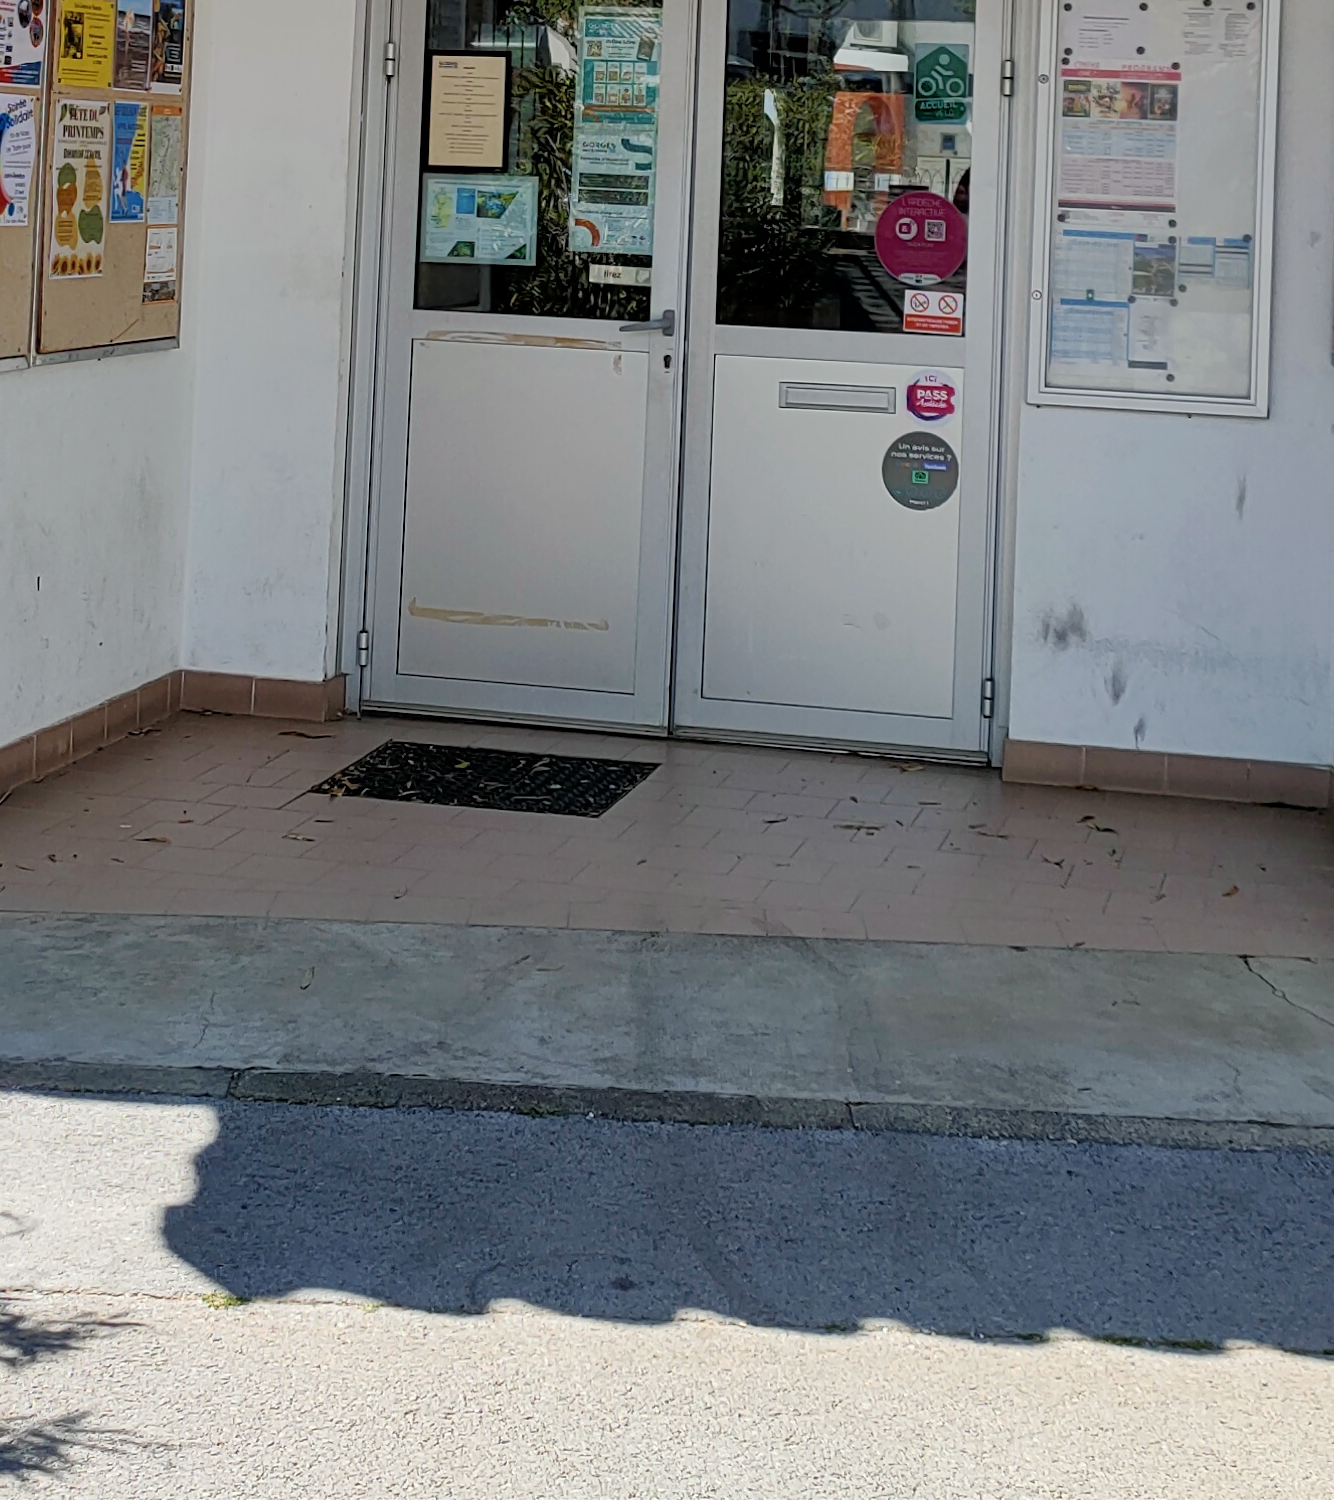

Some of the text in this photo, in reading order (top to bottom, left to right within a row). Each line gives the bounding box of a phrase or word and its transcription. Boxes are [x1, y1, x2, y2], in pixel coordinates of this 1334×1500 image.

[920, 100, 959, 110] ACCUEIL
[89, 108, 99, 122] DU
[63, 124, 104, 139] PRINTEMPS
[898, 207, 947, 217] INTERACTIVE
[604, 269, 622, 279] tirez
[917, 389, 948, 401] PASS
[898, 442, 946, 454] Un avis sur
[891, 451, 908, 459] nos
[908, 453, 944, 461] services
